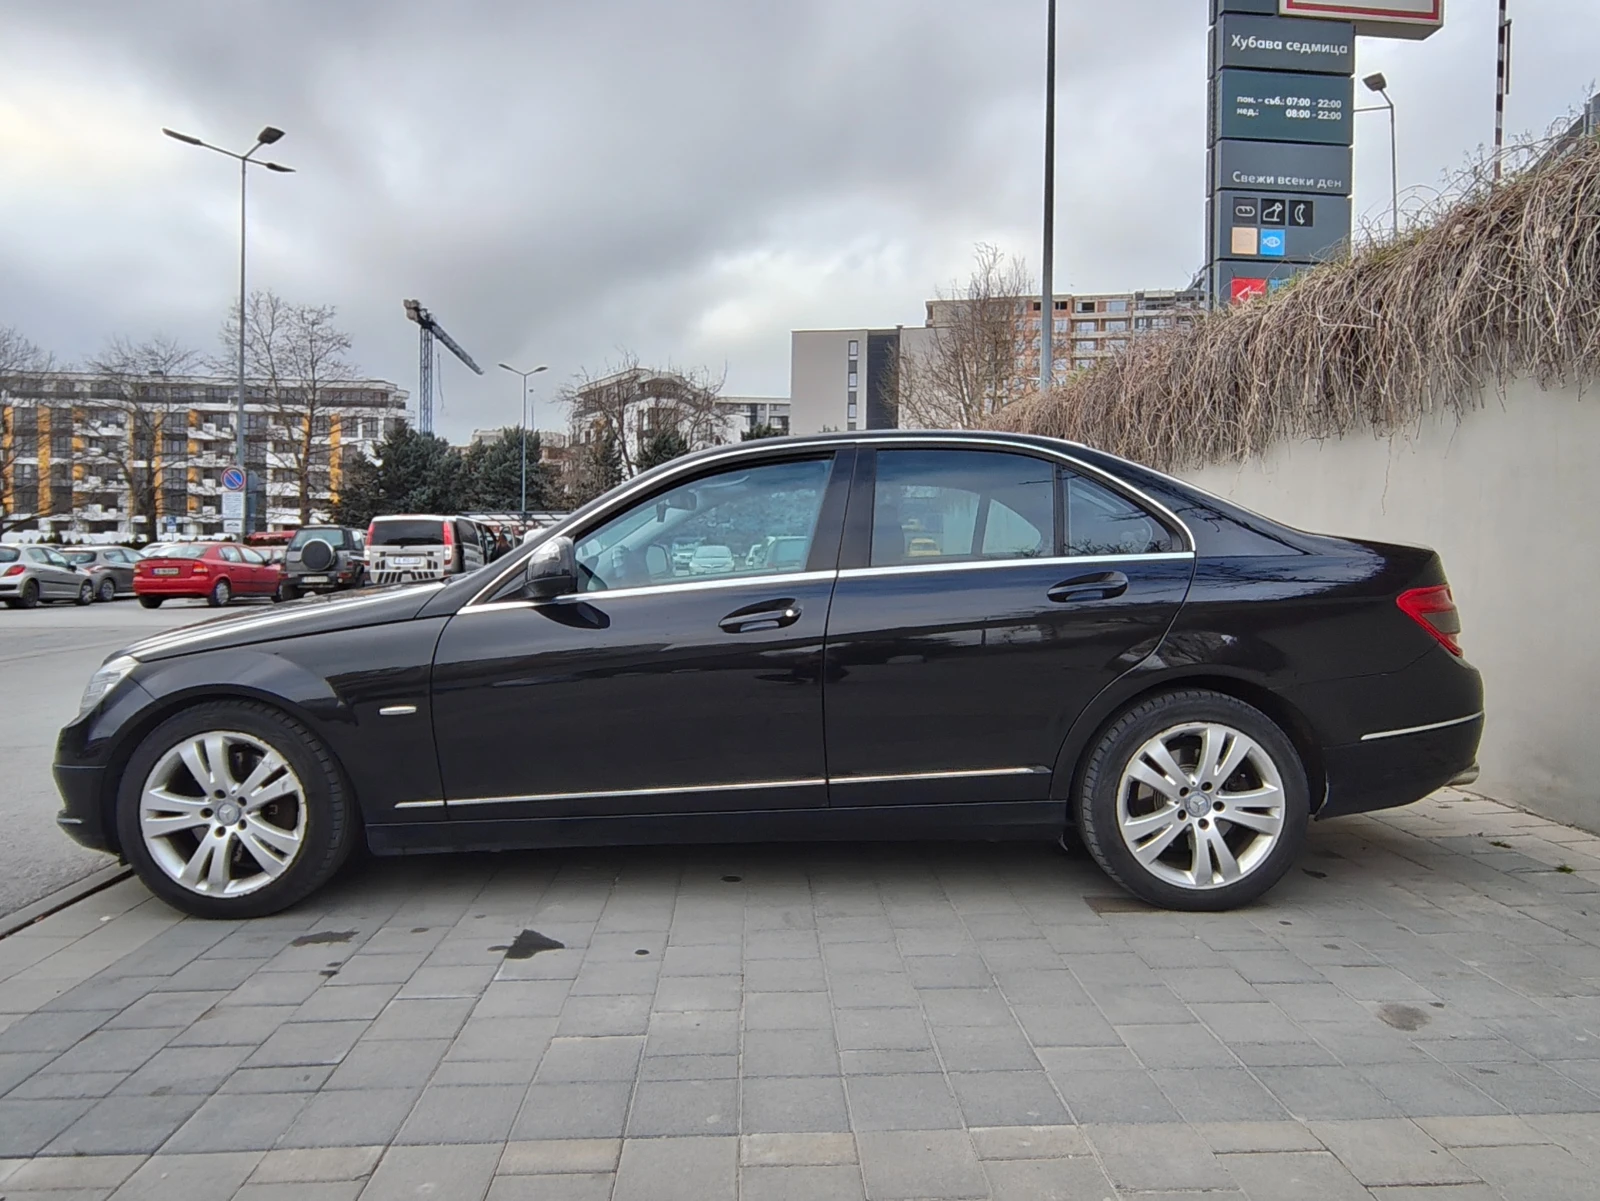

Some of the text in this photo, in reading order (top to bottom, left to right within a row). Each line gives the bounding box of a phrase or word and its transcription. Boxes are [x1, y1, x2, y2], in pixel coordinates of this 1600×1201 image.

[1231, 34, 1348, 56] Хубава седмица
[1237, 96, 1256, 104] пон.
[1286, 97, 1311, 107] 07:00
[1317, 99, 1342, 108] 22:00
[1285, 109, 1311, 118] 08:00
[1317, 111, 1342, 120] 22:00
[1232, 171, 1342, 189] Свежи всеки ден
